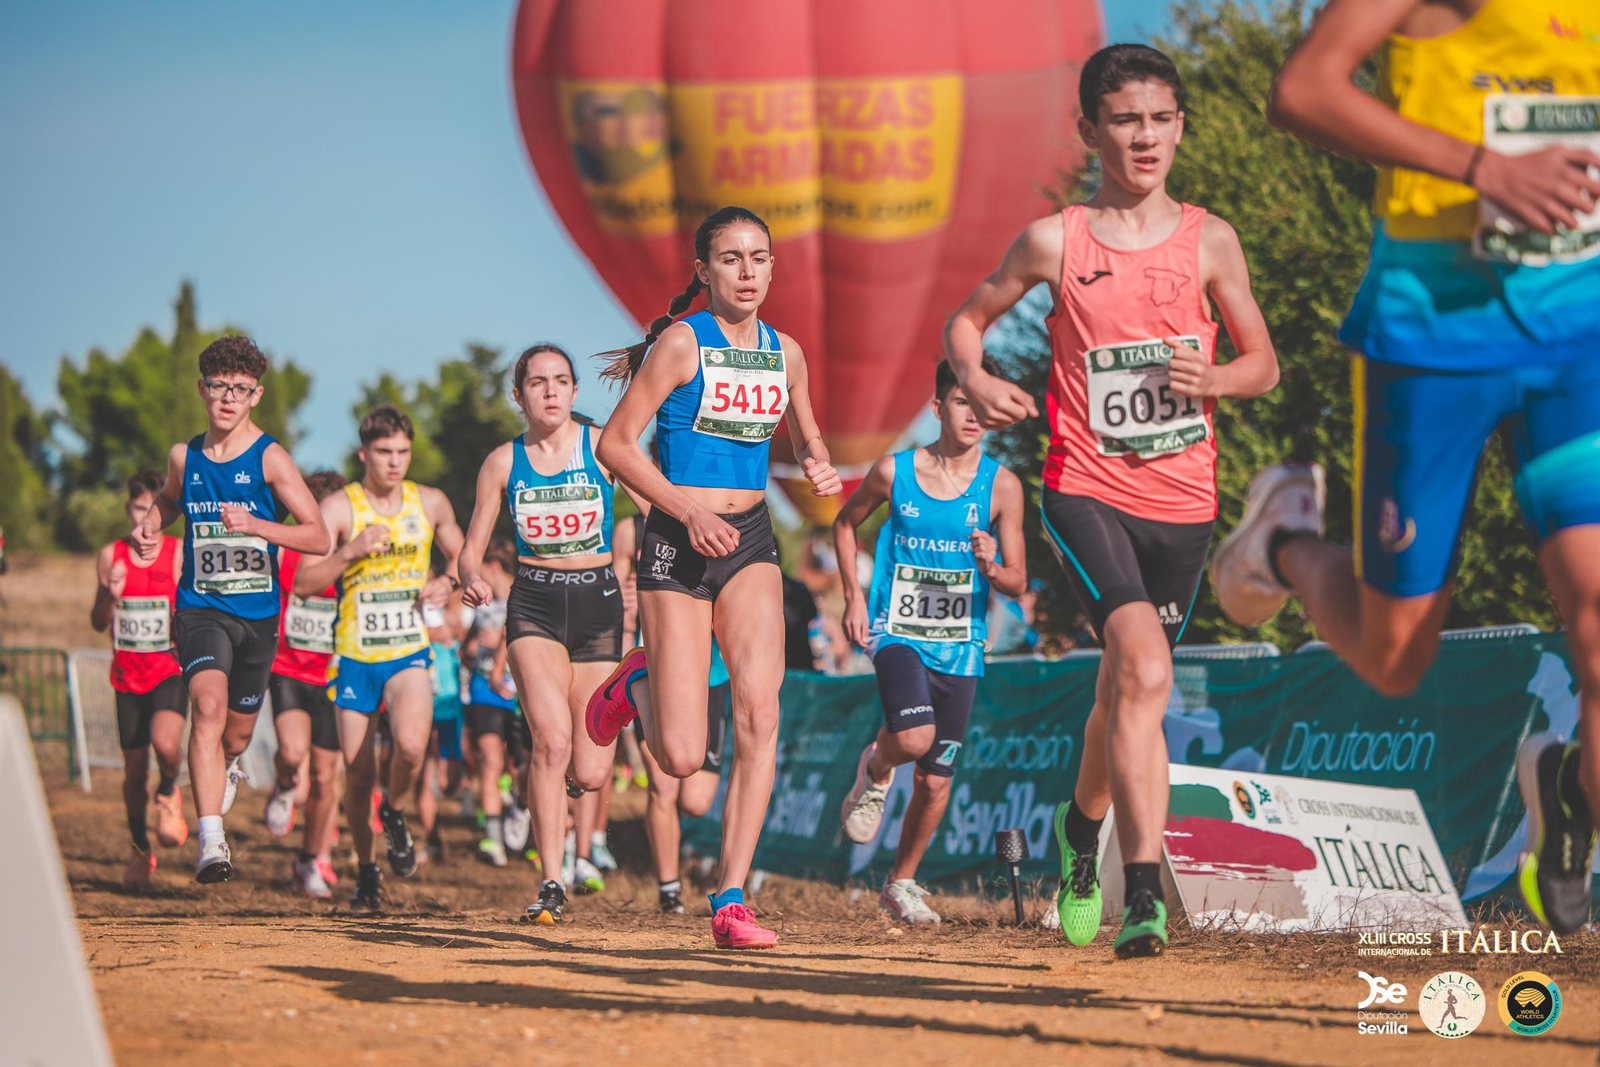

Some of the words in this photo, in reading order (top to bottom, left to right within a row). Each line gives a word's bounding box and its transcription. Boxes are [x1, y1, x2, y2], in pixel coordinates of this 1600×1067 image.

[714, 84, 935, 133] FUERZAS
[713, 138, 936, 188] ARMADAS
[712, 382, 781, 415] 5412
[1104, 386, 1197, 427] 6051
[527, 511, 597, 538] 5397
[894, 534, 974, 553] TROTASIERR
[201, 550, 266, 574] 8133
[550, 571, 597, 585] PRO
[898, 594, 967, 620] 8130
[120, 618, 164, 637] 8052
[365, 610, 417, 632] 8111
[1281, 717, 1436, 777] Diputación
[1298, 798, 1331, 816] CROSS
[1330, 802, 1407, 824] INTERNACIONAL
[1404, 811, 1420, 826] DE
[1313, 823, 1447, 895] ITÁLICA
